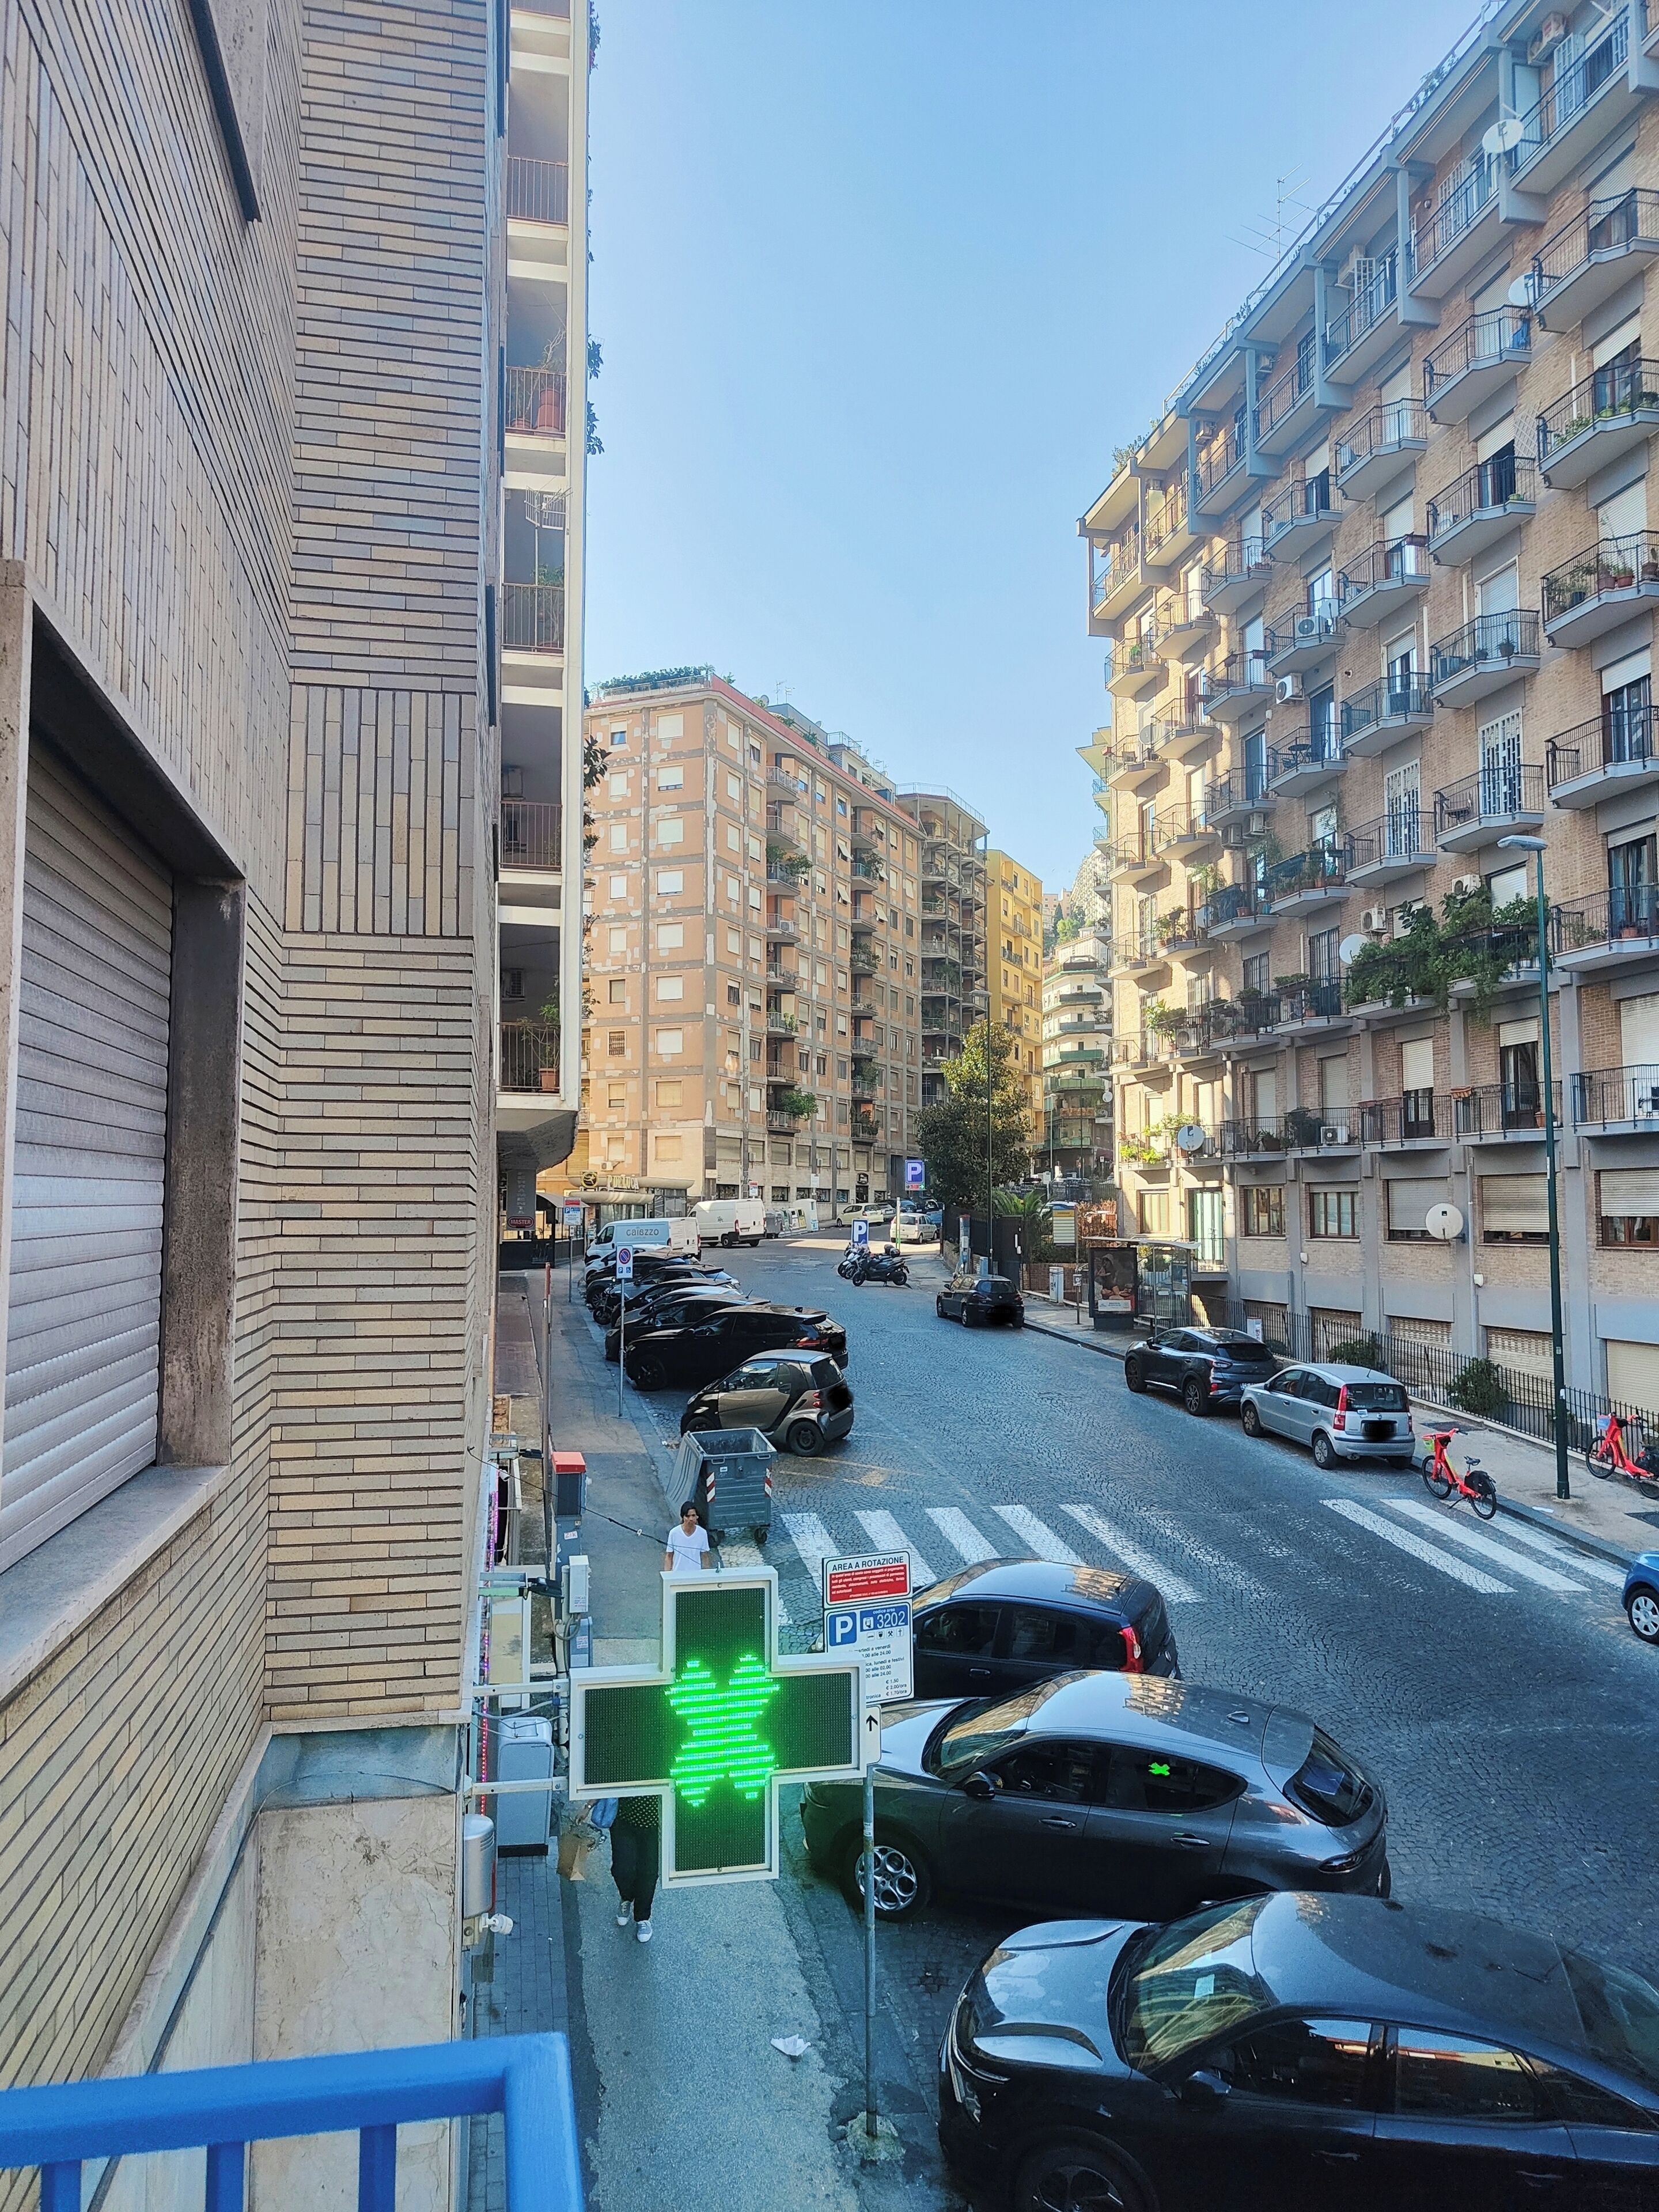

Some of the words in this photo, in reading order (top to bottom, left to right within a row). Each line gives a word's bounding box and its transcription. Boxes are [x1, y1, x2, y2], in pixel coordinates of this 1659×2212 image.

[907, 1162, 922, 1181] P
[854, 1221, 866, 1242] P
[832, 1562, 853, 1571] AREA
[862, 1556, 903, 1567] ROTAZIONE
[835, 1615, 853, 1643] P
[877, 1611, 906, 1628] 3202
